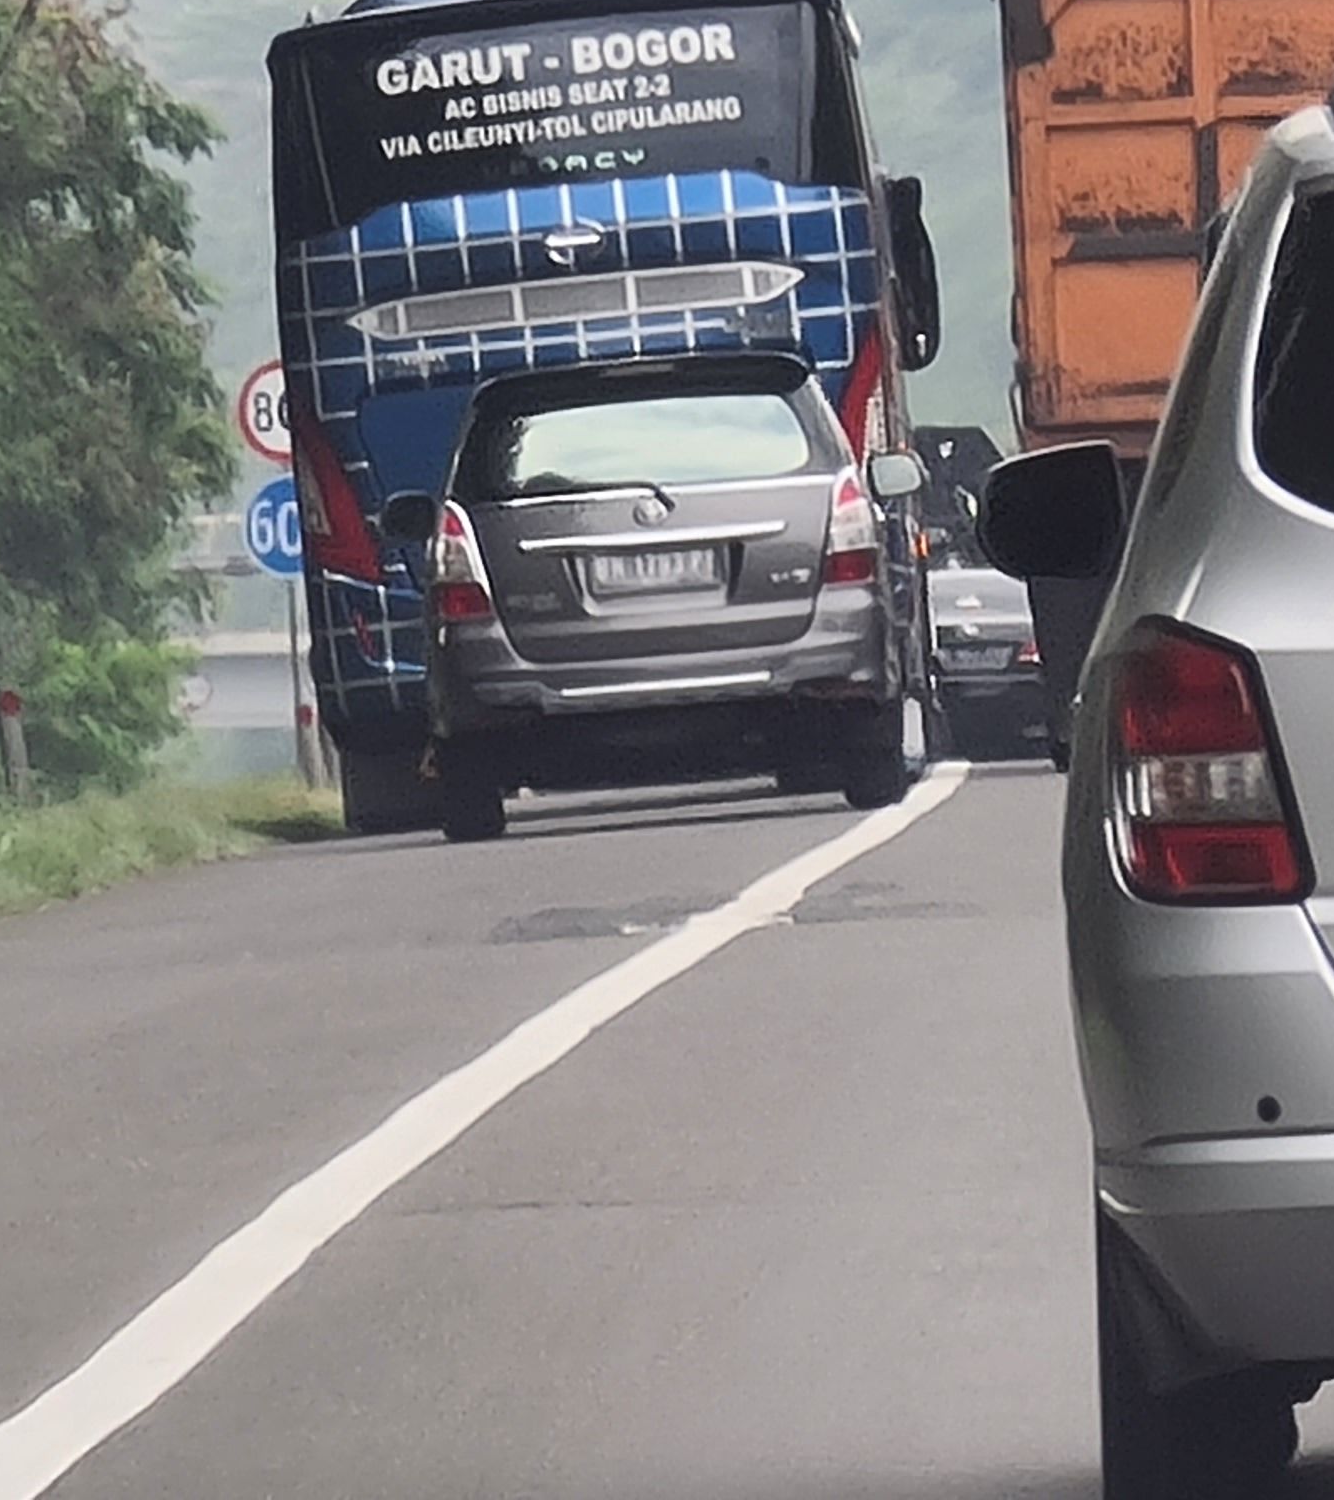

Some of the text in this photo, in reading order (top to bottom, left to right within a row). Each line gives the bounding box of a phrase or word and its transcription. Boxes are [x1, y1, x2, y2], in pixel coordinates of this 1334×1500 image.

[376, 43, 532, 96] GARUT
[570, 22, 736, 75] BOGOR
[380, 134, 423, 160] VIA
[590, 95, 742, 135] CIPULARANG
[444, 96, 477, 121] AC
[567, 77, 629, 106] SEAT
